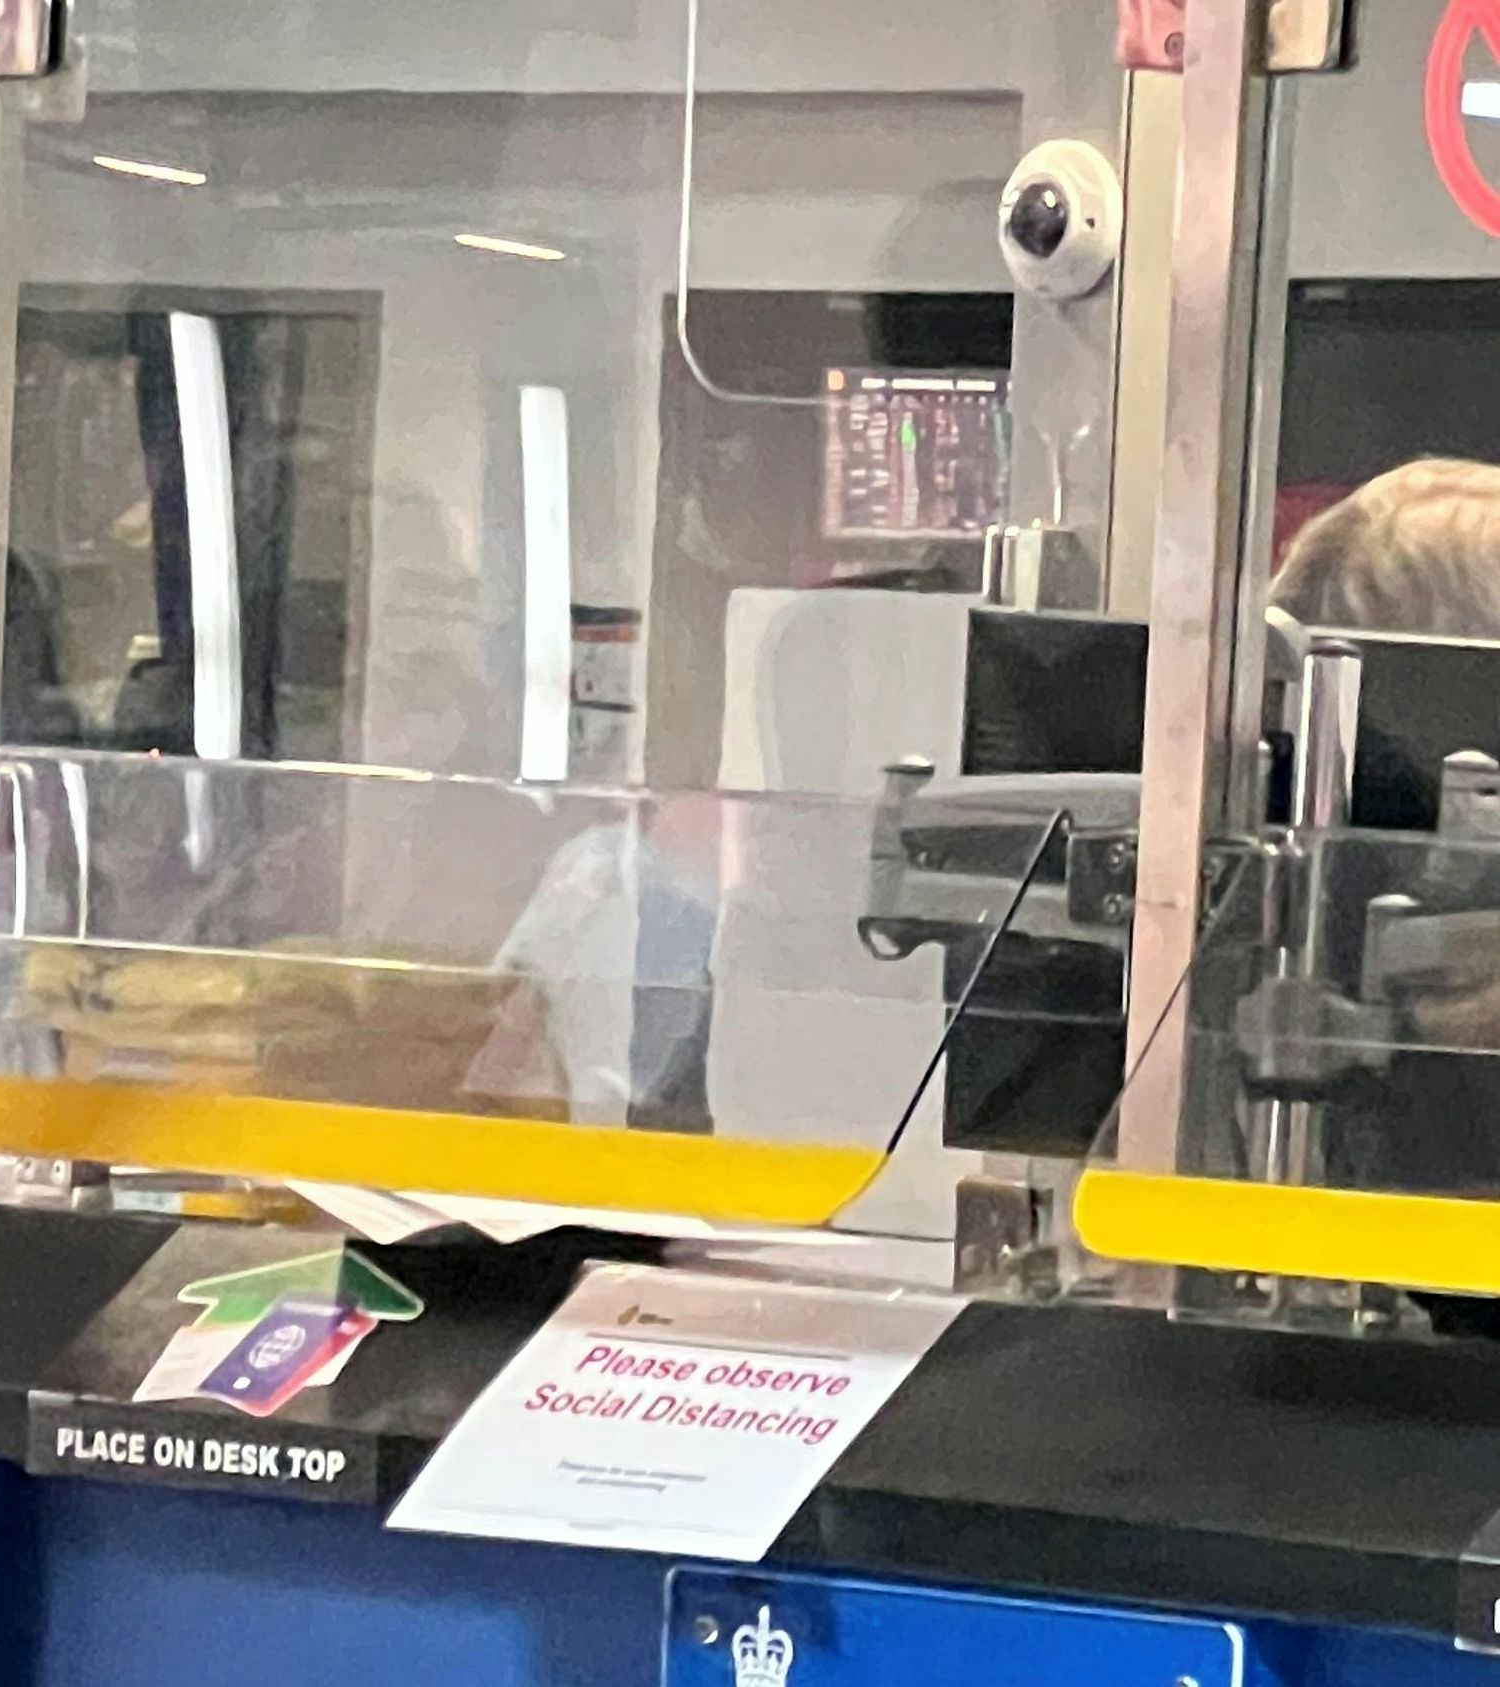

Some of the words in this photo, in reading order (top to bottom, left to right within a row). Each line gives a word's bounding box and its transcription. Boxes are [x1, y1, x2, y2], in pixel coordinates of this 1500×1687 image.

[575, 1345, 698, 1381] Please
[704, 1360, 852, 1397] observe
[524, 1382, 643, 1419] Social
[641, 1394, 839, 1446] Distancing
[57, 1427, 146, 1464] PLACE
[153, 1435, 195, 1469] ON
[202, 1439, 280, 1477] DESK
[286, 1446, 346, 1483] TOP
